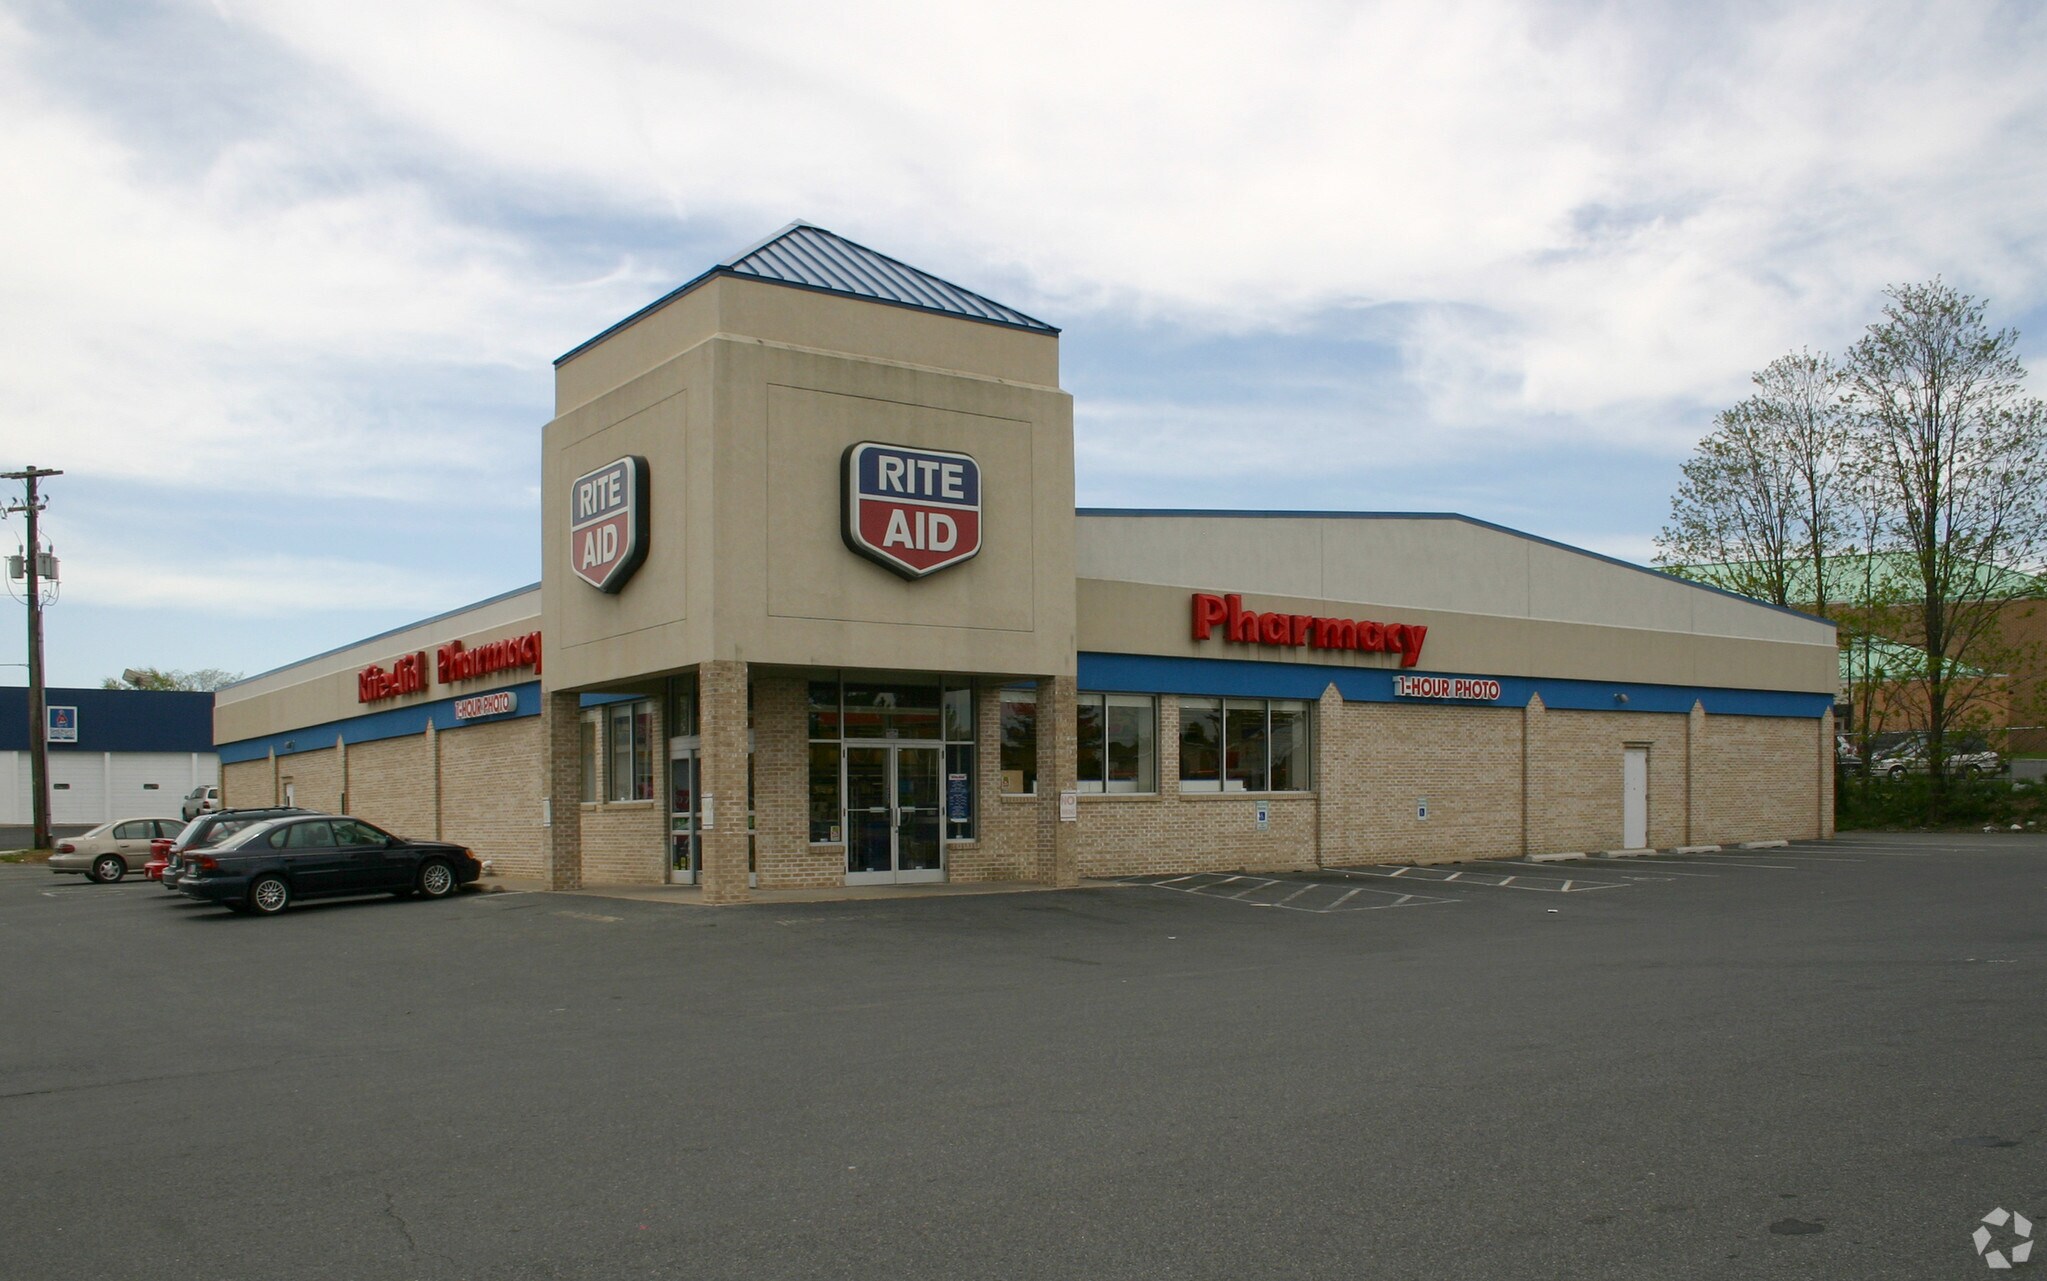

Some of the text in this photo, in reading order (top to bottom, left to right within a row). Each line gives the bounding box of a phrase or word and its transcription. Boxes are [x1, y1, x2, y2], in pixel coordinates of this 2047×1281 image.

[580, 469, 621, 518] RITE
[878, 455, 964, 499] RITE
[582, 523, 618, 569] AID
[882, 508, 957, 552] AID
[1191, 593, 1428, 667] Pharmacy
[438, 631, 542, 684] Pharmacy
[455, 691, 510, 720] 1-HOUR PHOTO
[1398, 676, 1500, 700] 1-HOUR PHOTO
